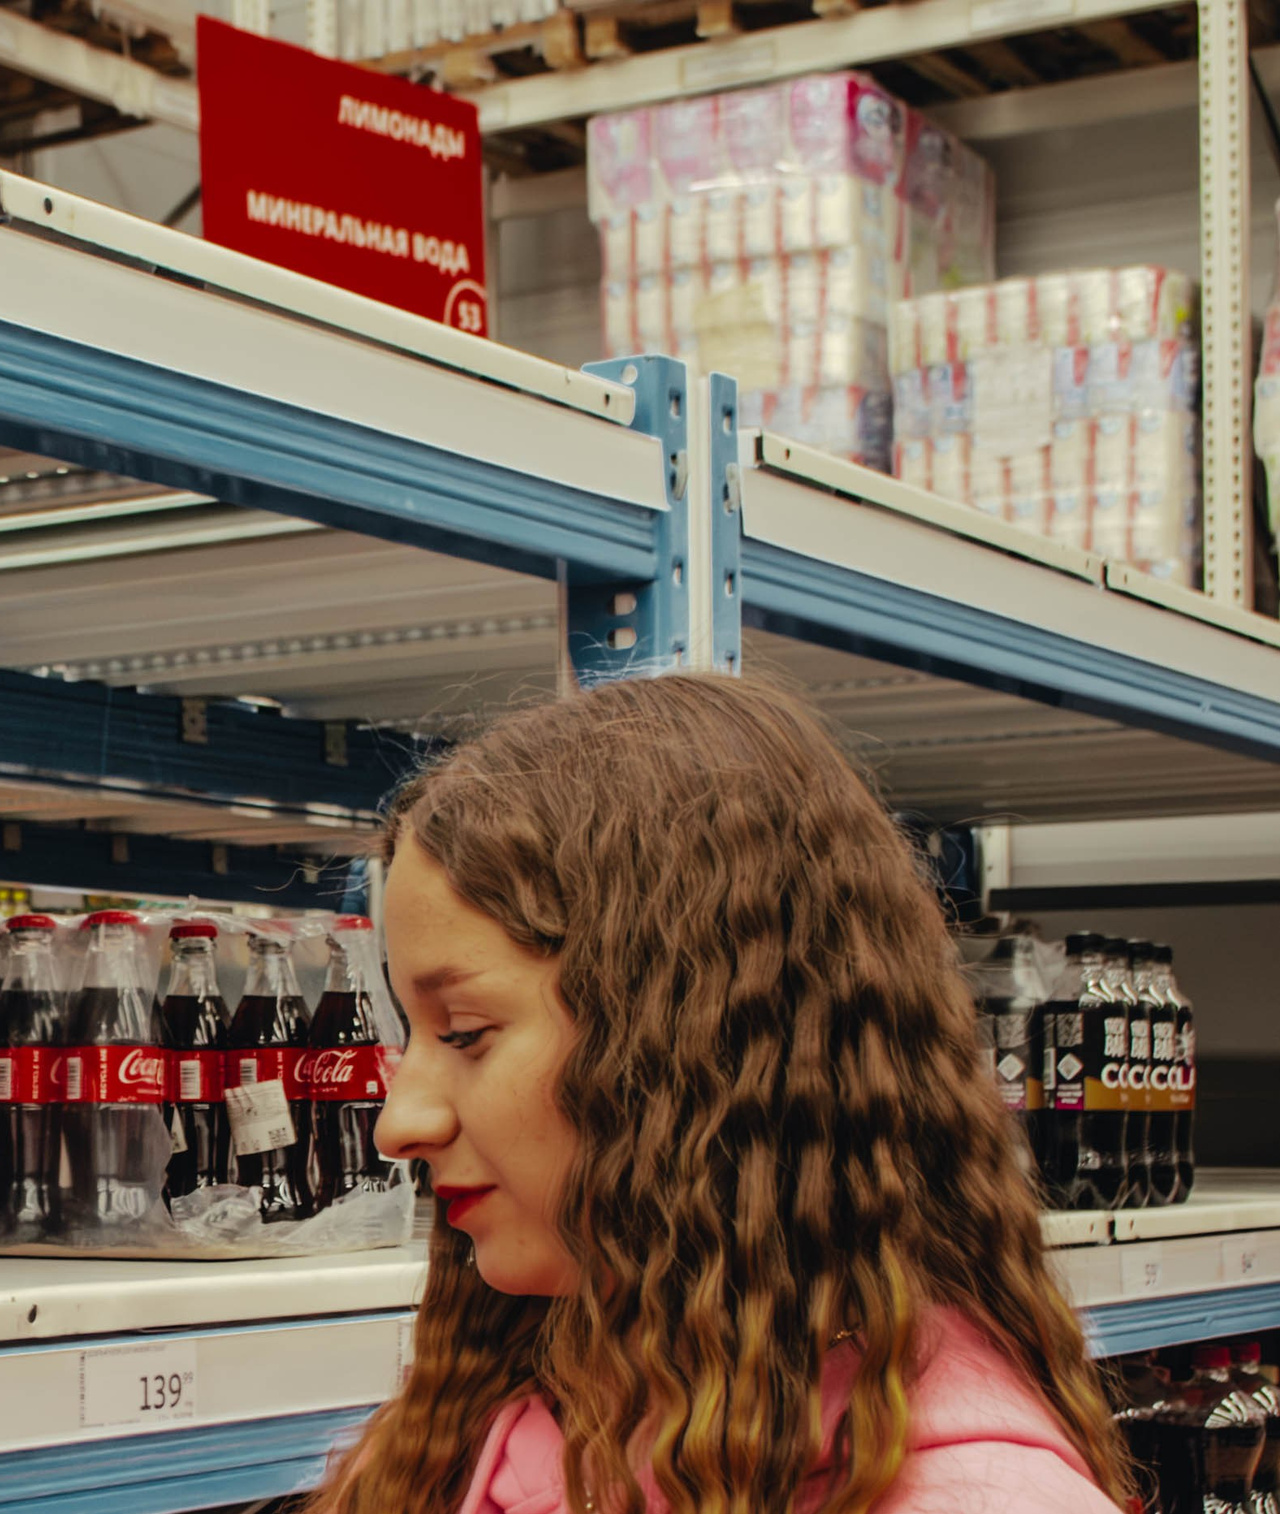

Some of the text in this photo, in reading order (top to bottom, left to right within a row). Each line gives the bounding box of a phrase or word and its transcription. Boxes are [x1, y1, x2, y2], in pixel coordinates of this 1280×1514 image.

[338, 94, 465, 161] ЛИМОНАДЫ
[246, 189, 470, 277] МИНЕРАЛЬНАЯ ВОДА
[139, 1373, 181, 1411] 139
